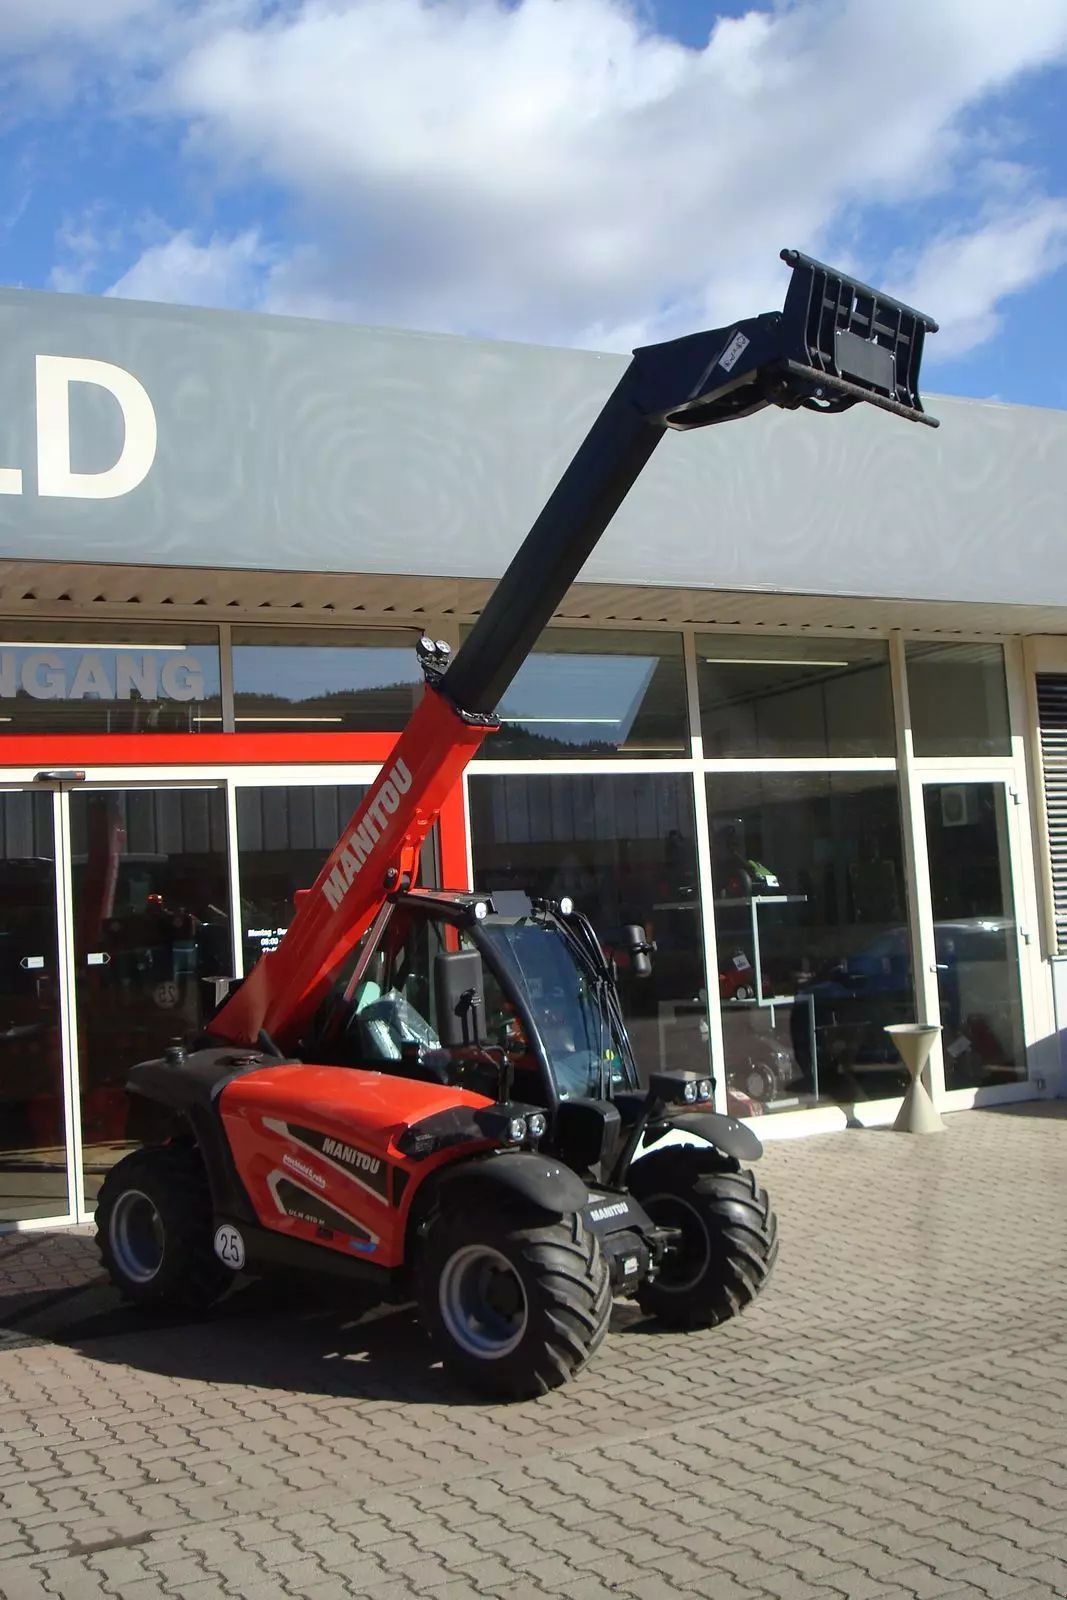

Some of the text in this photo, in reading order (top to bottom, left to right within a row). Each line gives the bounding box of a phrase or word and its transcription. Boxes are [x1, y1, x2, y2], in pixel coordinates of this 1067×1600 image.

[0, 355, 157, 498] D
[322, 758, 412, 911] MANITOU
[322, 1137, 380, 1174] MANITOU
[590, 1201, 629, 1222] MANITOU
[220, 1233, 239, 1262] 25
